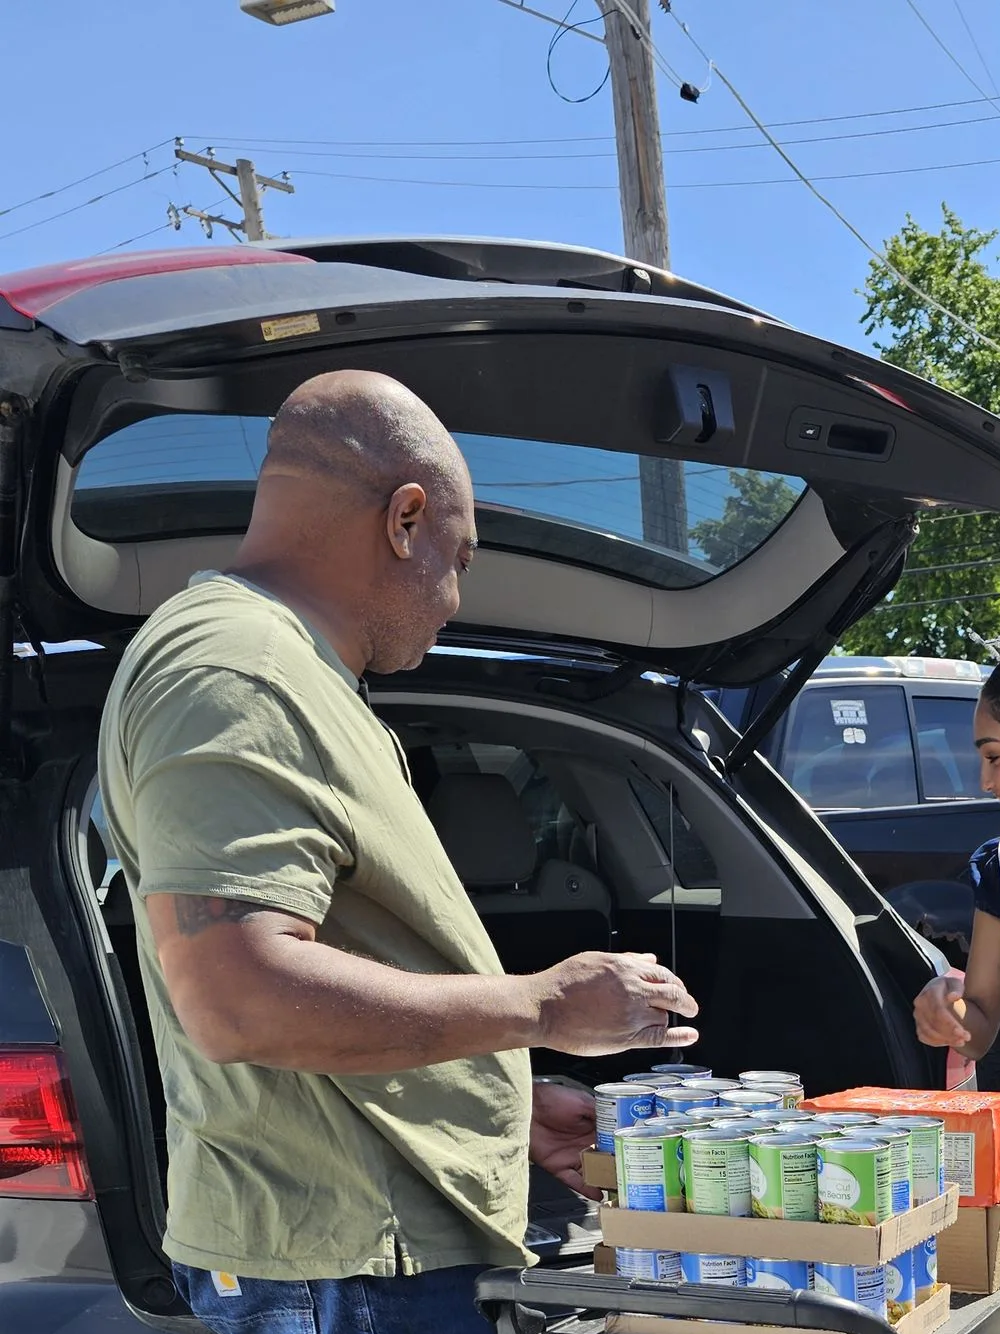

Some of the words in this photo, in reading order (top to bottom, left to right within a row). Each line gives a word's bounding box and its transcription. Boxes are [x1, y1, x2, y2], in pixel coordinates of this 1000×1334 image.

[719, 1170, 727, 1178] 15
[835, 1183, 851, 1192] Cut
[827, 1191, 852, 1201] Beans
